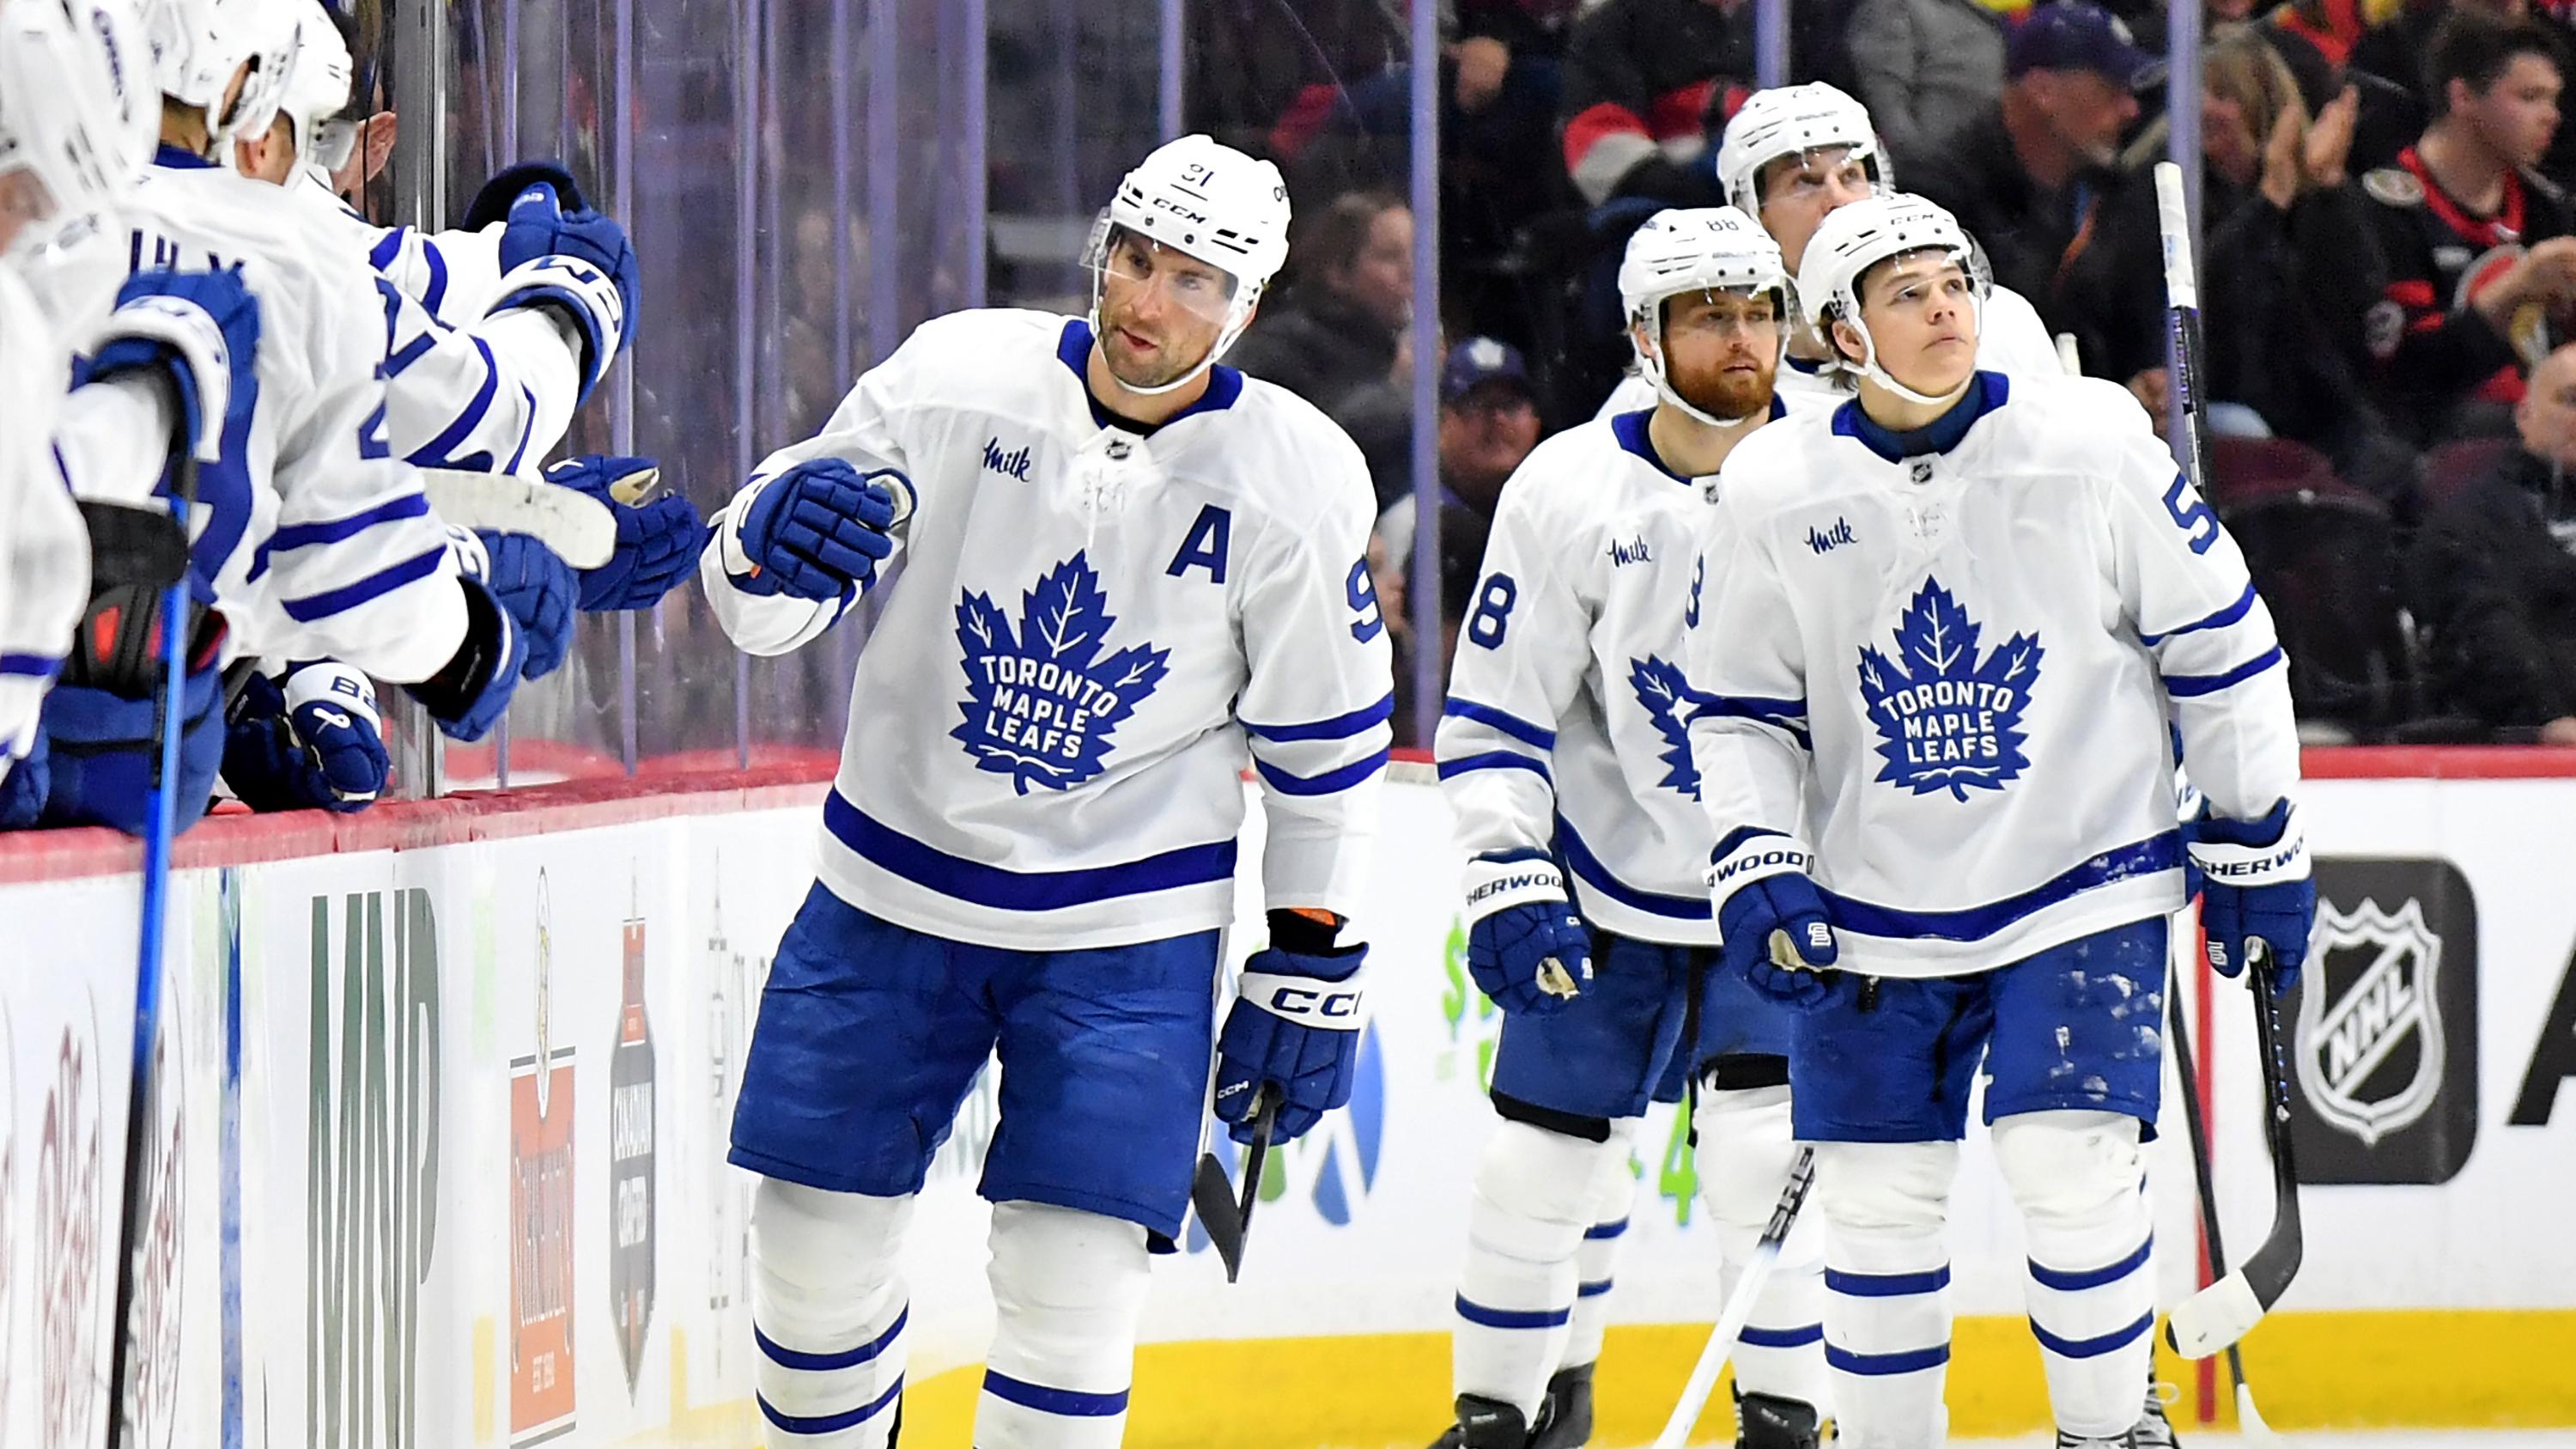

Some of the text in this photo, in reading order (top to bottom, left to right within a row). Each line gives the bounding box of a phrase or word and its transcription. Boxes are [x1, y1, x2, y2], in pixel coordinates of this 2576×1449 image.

[1181, 163, 1215, 187] 91
[1152, 197, 1207, 224] CCM
[983, 436, 1031, 483] Milk
[1165, 502, 1231, 584] A
[1607, 533, 1652, 568] Milk
[1804, 515, 1859, 555] Milk
[1467, 571, 1518, 651] 8
[979, 655, 1118, 718] TORONTO
[1879, 680, 2014, 721] TORONTO
[993, 684, 1091, 733] MAPLE
[1903, 710, 1995, 740] MAPLE
[985, 710, 1082, 758] LEAFS
[1906, 735, 1999, 764] LEAFS
[1271, 987, 1364, 1017] CC
[2329, 963, 2413, 1085] NHL
[1218, 1080, 1249, 1099] CCM
[307, 886, 440, 1449] MNP
